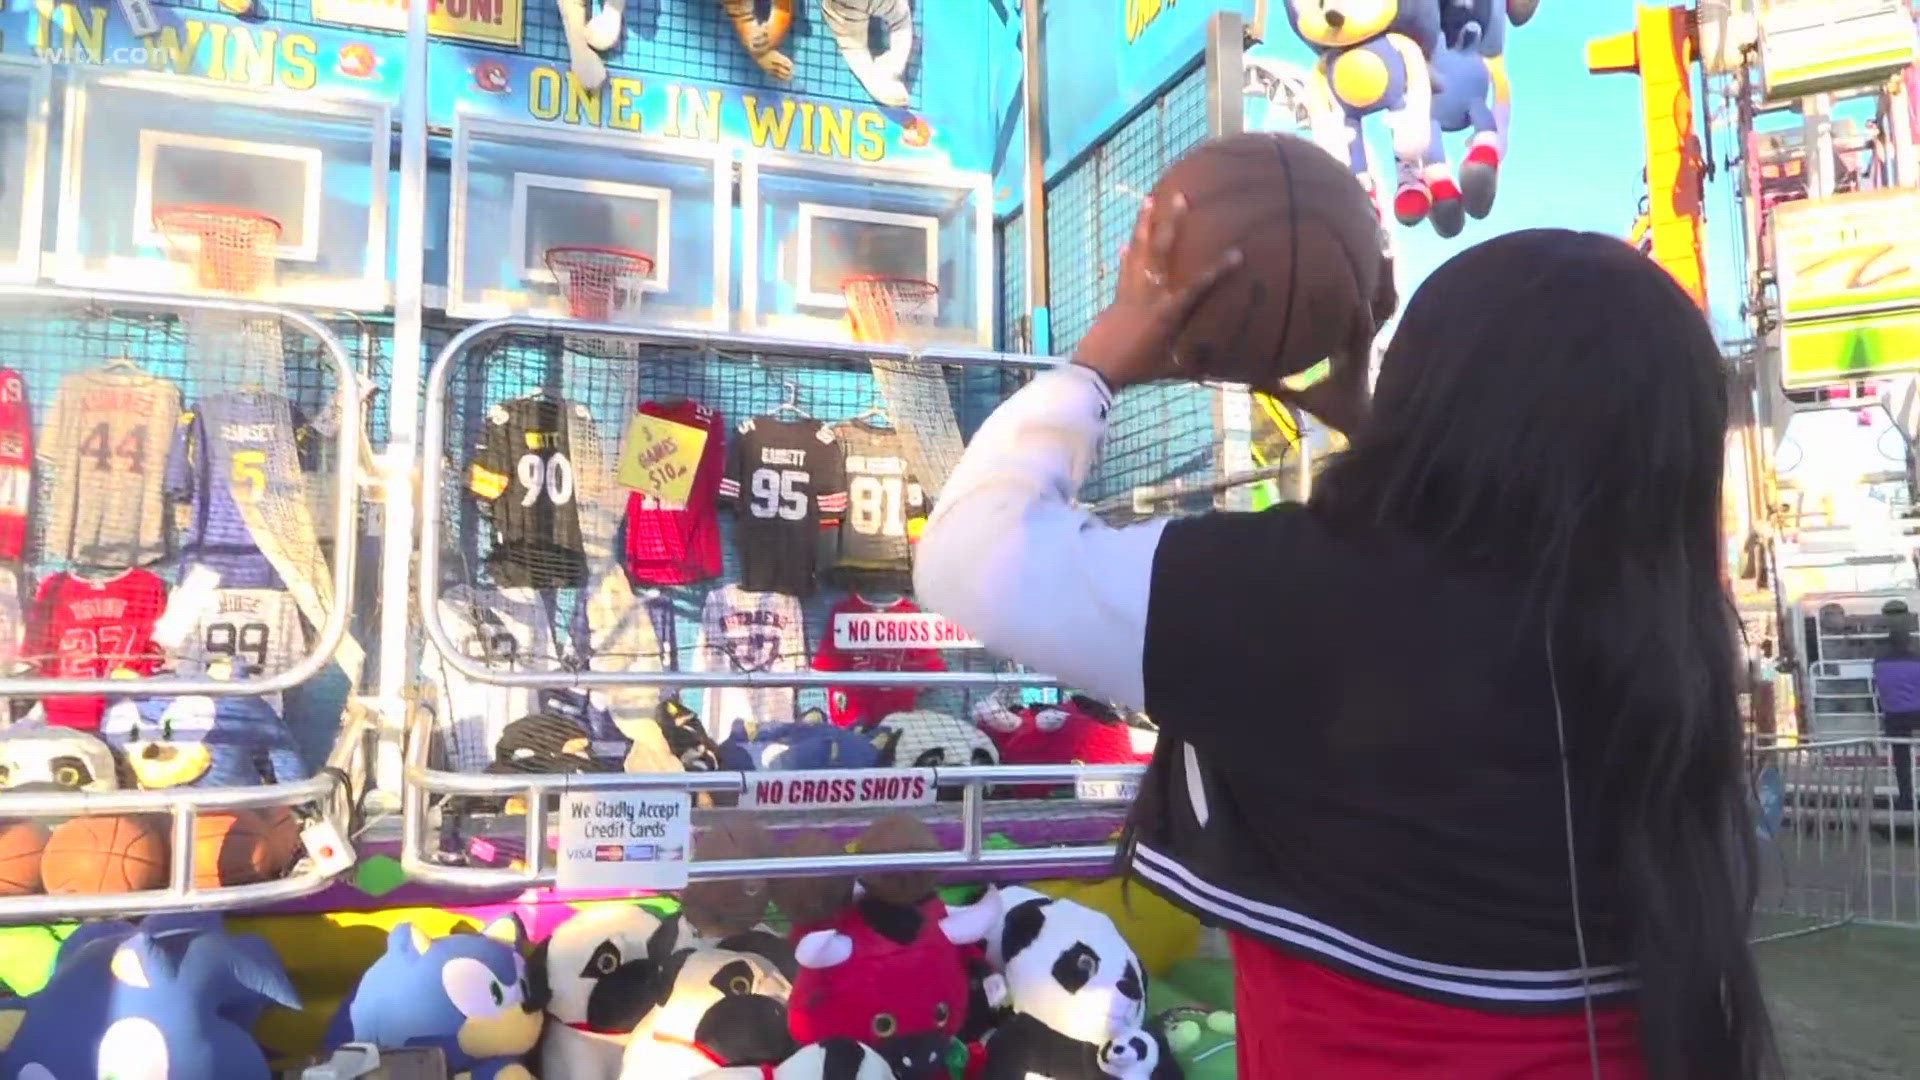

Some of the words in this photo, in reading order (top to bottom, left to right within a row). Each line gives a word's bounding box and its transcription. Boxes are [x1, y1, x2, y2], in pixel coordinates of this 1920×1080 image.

[142, 18, 318, 90] WINS
[528, 66, 643, 133] ONE
[663, 85, 722, 143] IN
[742, 94, 886, 162] WINS
[232, 450, 266, 504] 5
[517, 452, 573, 507] 90
[750, 466, 811, 522] 95
[849, 475, 905, 537] 81
[848, 619, 871, 642] NO
[875, 620, 930, 642] CROSS
[571, 801, 591, 818] We
[595, 801, 635, 821] Gladly
[638, 801, 680, 821] Accept
[756, 780, 783, 804] NO
[788, 779, 856, 803] CROSS
[860, 776, 925, 801] SHOTS
[566, 847, 593, 860] VISA
[584, 822, 625, 838] Credit
[629, 822, 666, 838] Cards
